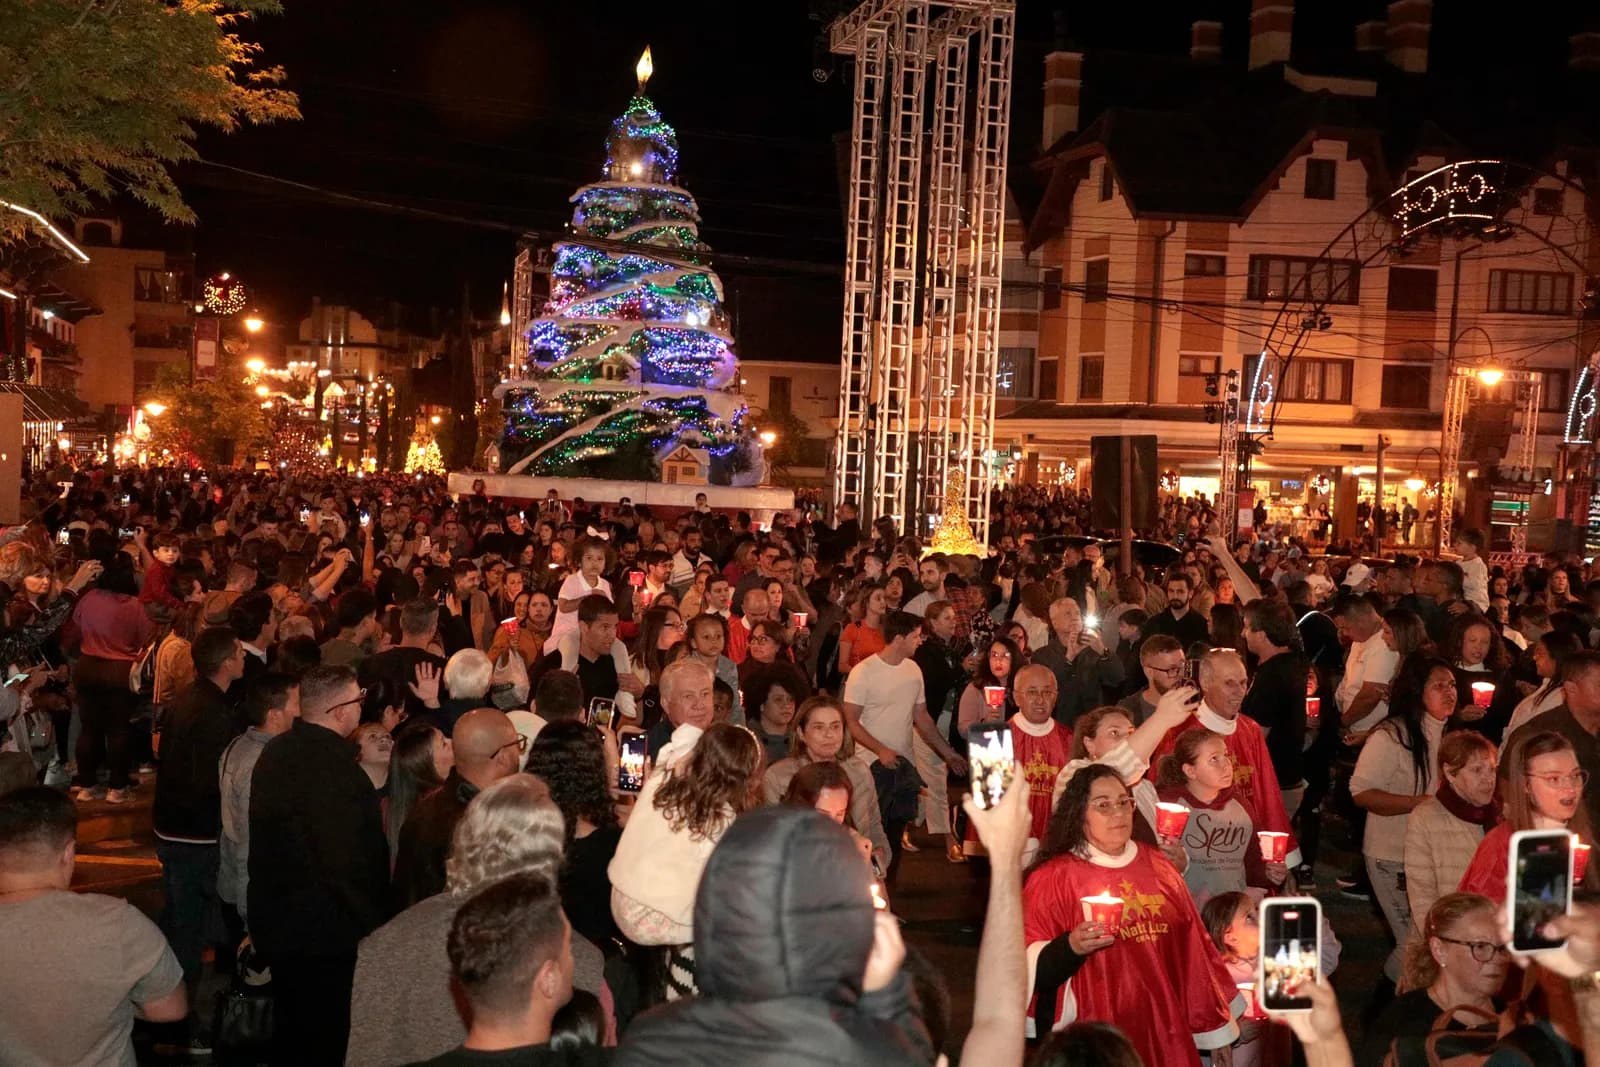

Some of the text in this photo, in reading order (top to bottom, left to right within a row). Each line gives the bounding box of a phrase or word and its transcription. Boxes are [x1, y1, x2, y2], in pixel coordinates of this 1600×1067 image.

[1185, 813, 1246, 858] Spin
[1119, 921, 1148, 941] Nat
[1148, 920, 1169, 935] Luz
